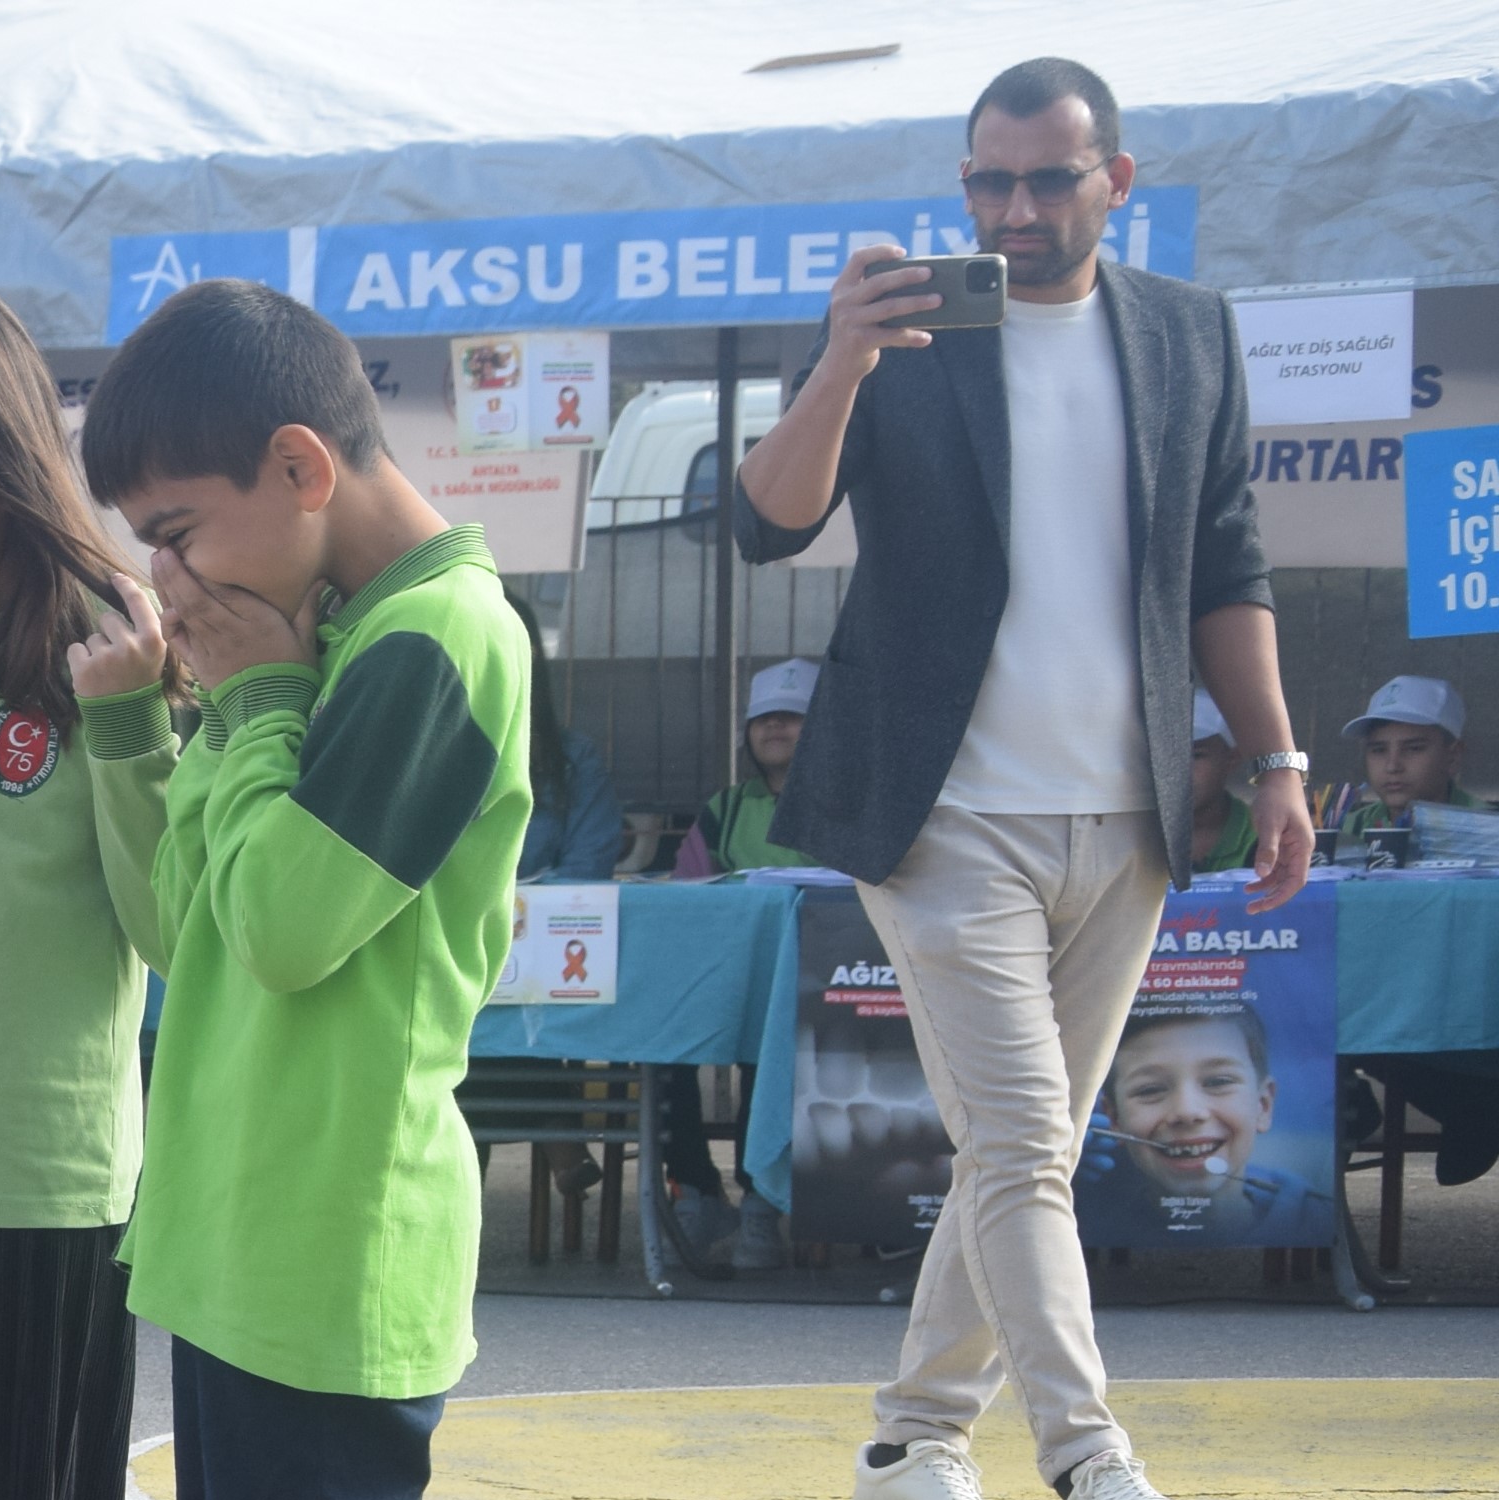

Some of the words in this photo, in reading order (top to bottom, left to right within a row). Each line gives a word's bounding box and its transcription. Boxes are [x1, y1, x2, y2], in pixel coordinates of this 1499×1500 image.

[346, 244, 583, 312] AKSU
[1247, 341, 1283, 359] AĞIZ
[1287, 341, 1306, 356] VE
[1308, 339, 1332, 356] DİŞ
[1336, 333, 1395, 353] SAĞLIĞI
[1278, 361, 1363, 379] İSTASYONU
[6, 748, 35, 772] 75
[1185, 928, 1299, 954] BAŞLAR
[829, 960, 903, 986] AĞIZ
[1151, 959, 1245, 971] travmalarında
[1153, 976, 1171, 987] 60
[1174, 975, 1239, 988] dakikada
[1150, 991, 1208, 1003] müdahale,
[1210, 989, 1239, 1001] kalıcı
[1242, 990, 1259, 1003] diş
[1185, 1000, 1247, 1016] önleyebilir.
